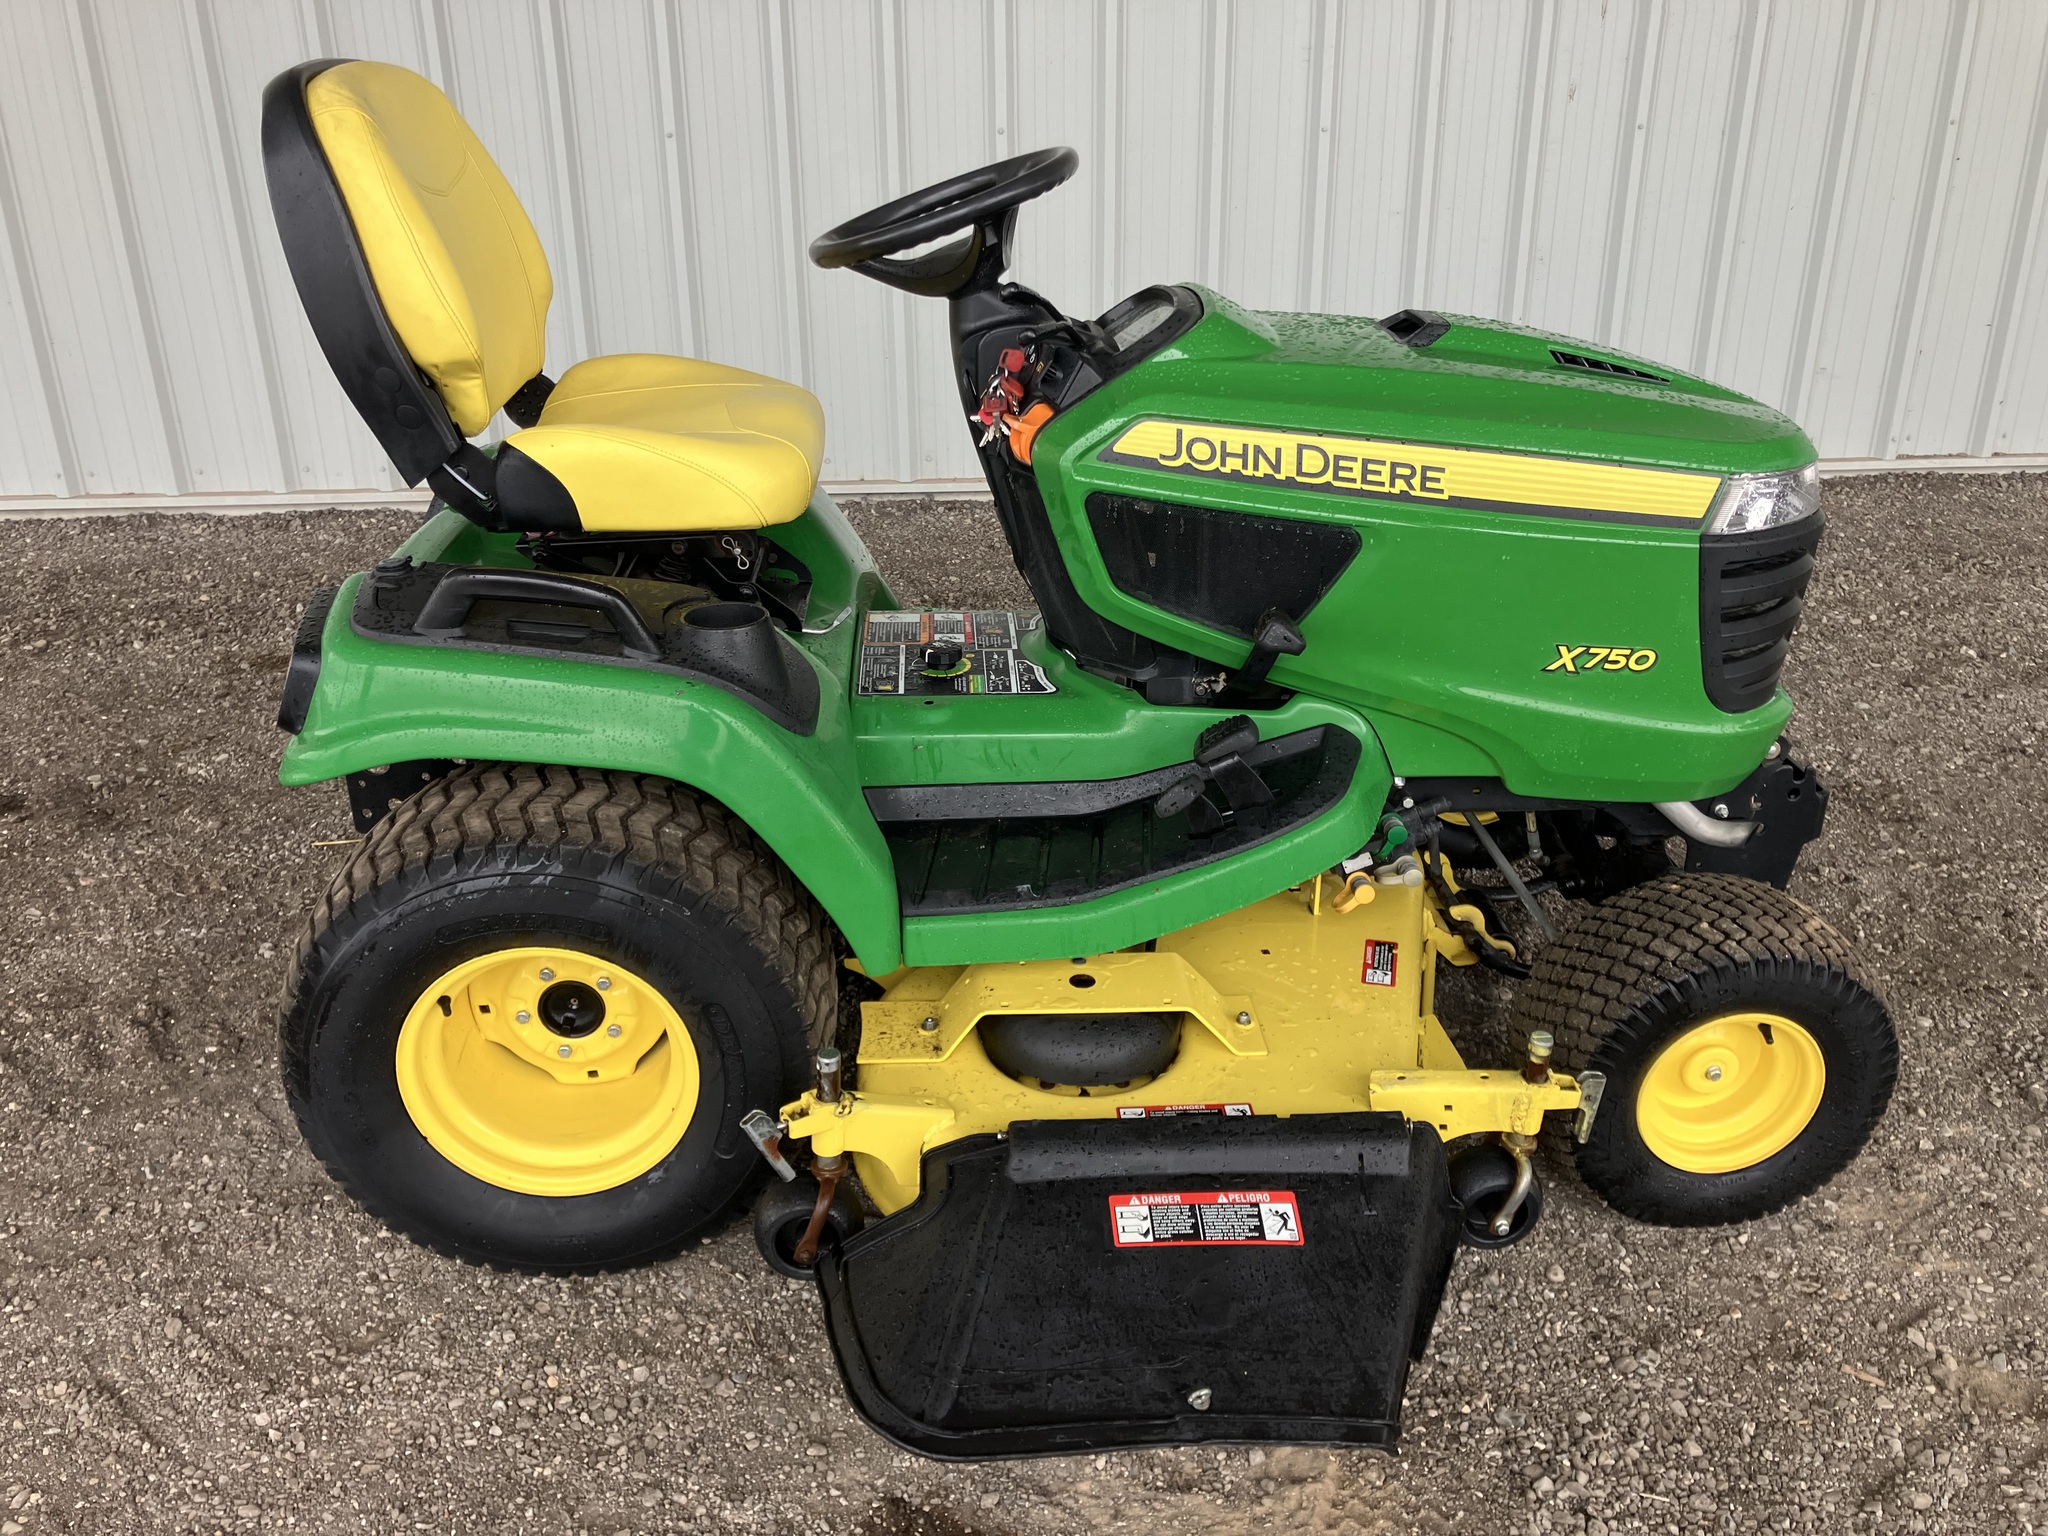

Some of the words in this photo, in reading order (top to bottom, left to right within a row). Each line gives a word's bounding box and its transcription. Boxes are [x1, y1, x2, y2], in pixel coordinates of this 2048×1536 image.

[1159, 428, 1285, 478] JOHN
[1295, 442, 1448, 498] DEERE
[1541, 644, 1657, 673] X750
[1141, 1195, 1182, 1204] DANGER
[1228, 1193, 1270, 1202] PELIGRO
